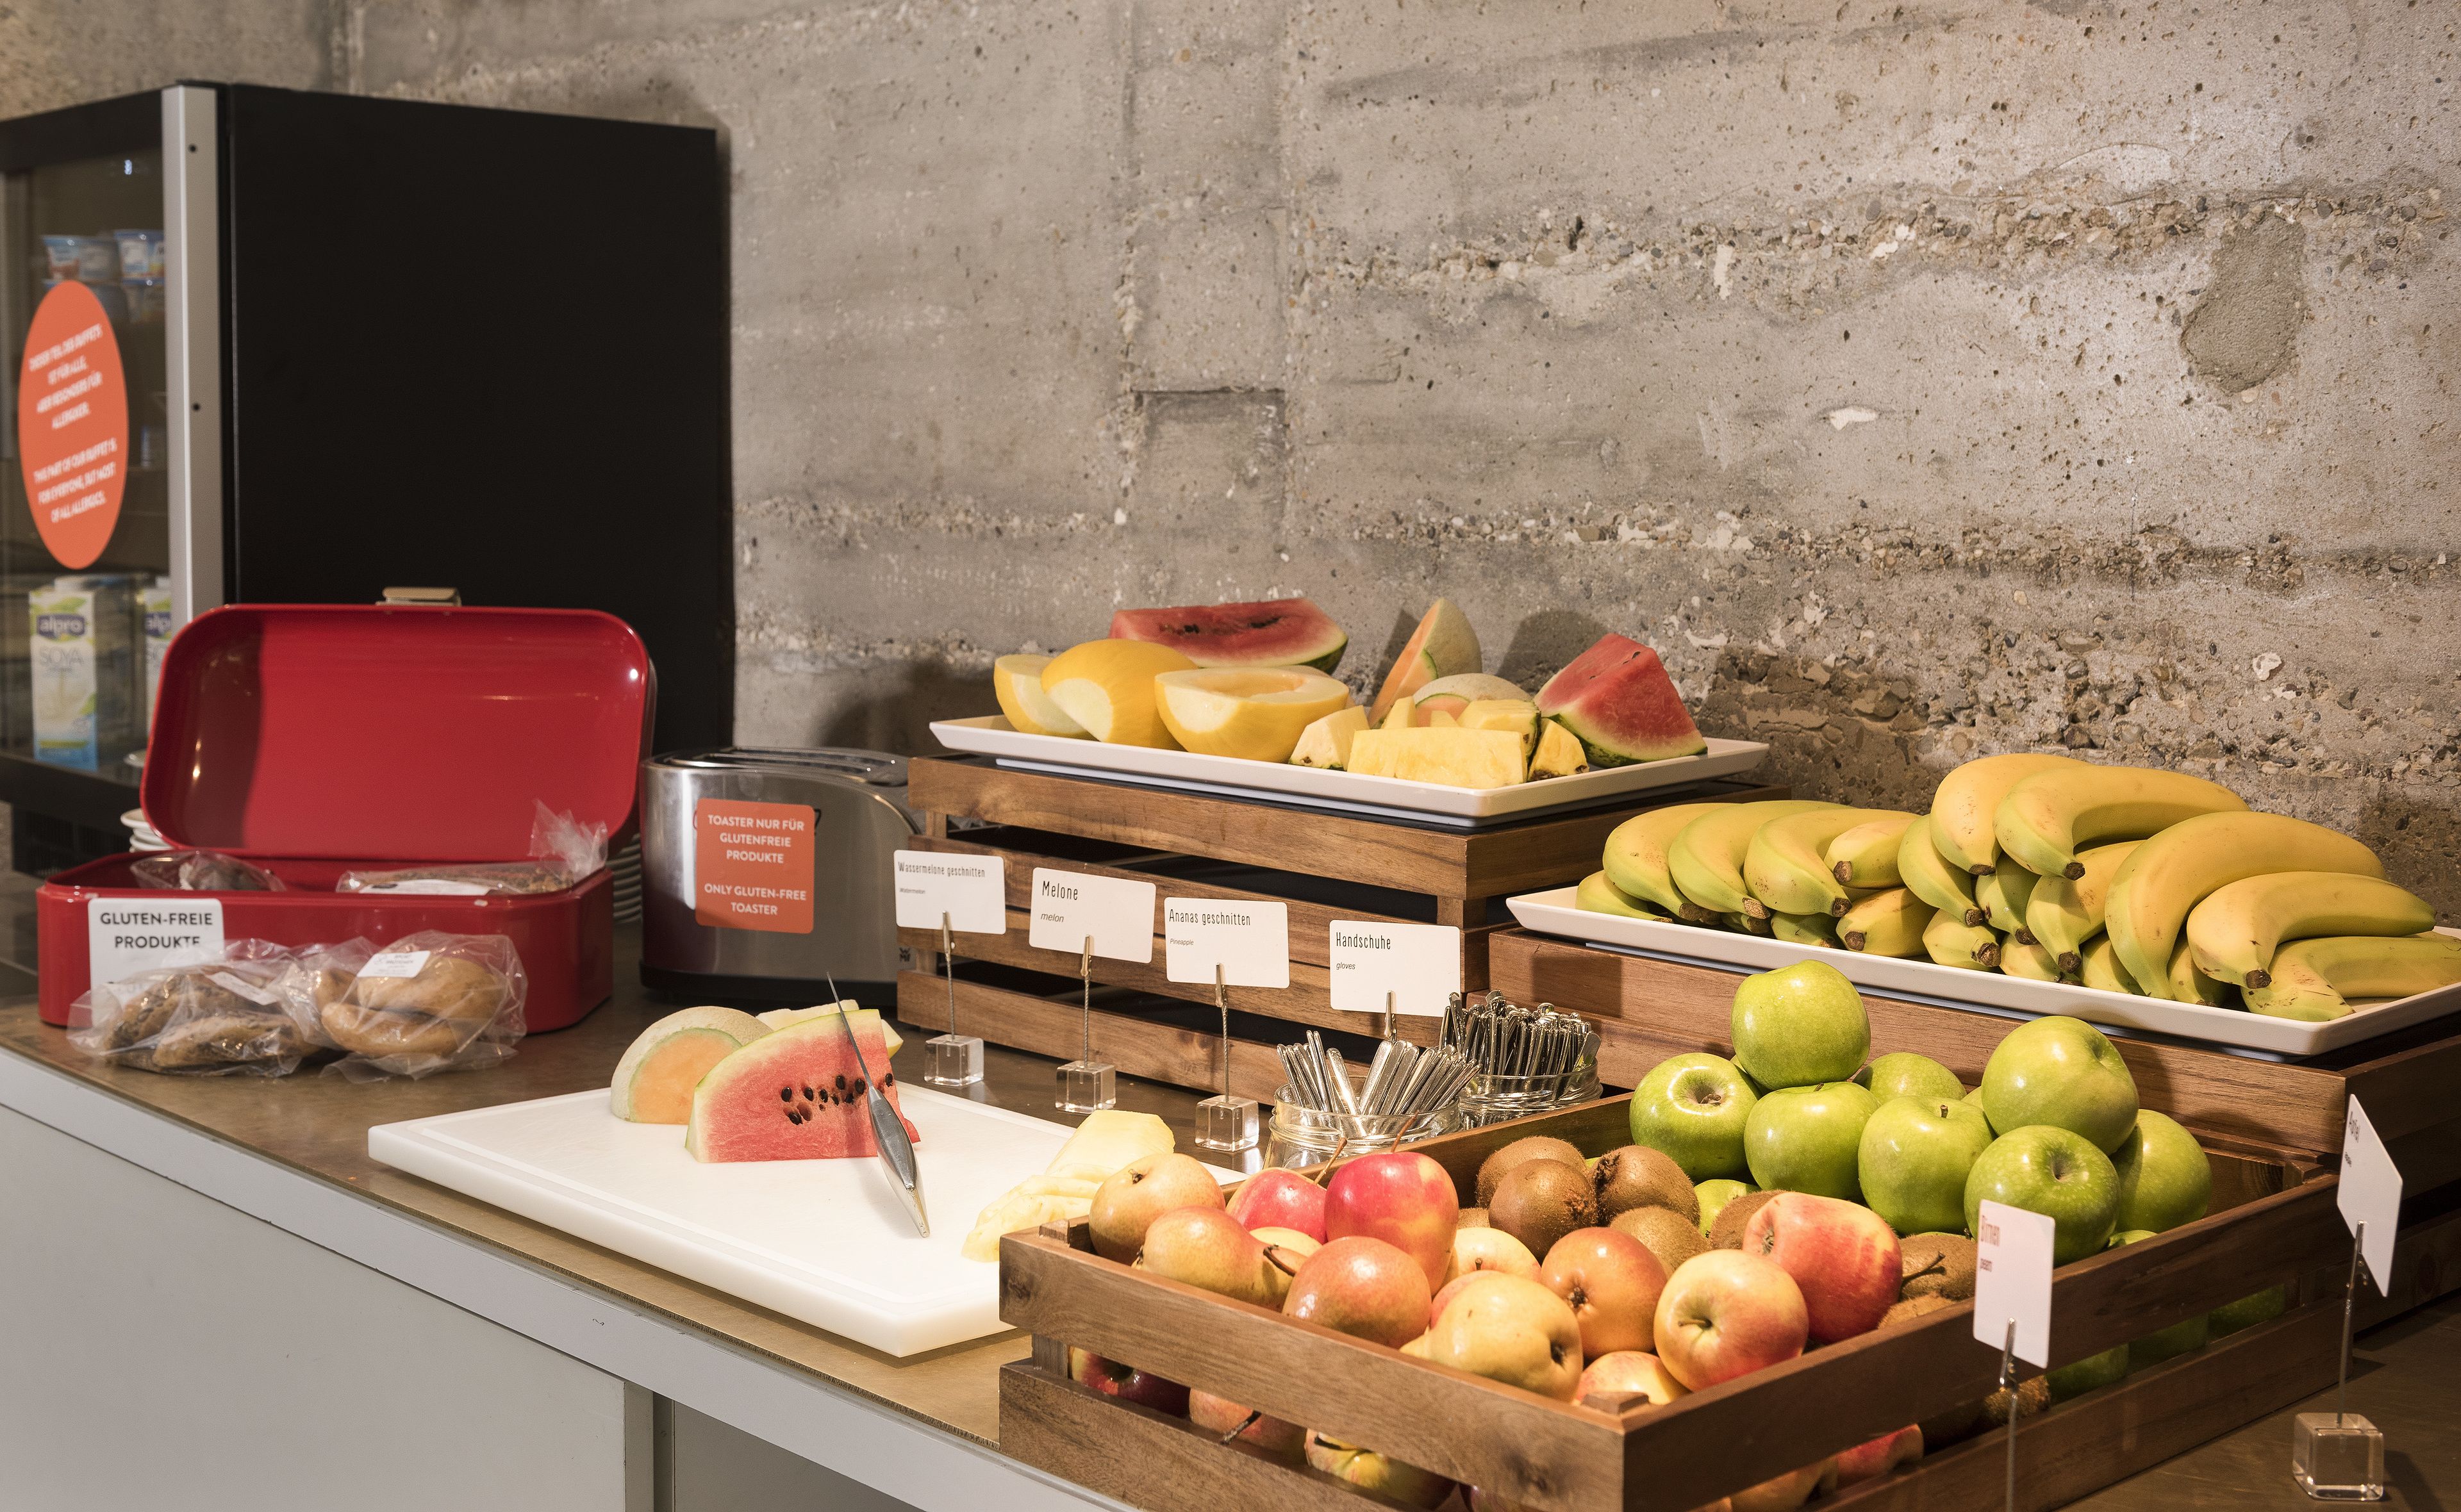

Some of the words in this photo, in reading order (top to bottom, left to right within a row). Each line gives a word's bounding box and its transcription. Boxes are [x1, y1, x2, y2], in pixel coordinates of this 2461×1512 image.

[62, 456, 70, 473] OF
[70, 450, 86, 468] OUR
[85, 440, 108, 463] BUFFET
[38, 489, 51, 505] FOR
[84, 468, 96, 487] BUT
[96, 461, 115, 481] MOST
[40, 614, 83, 636] alpro
[39, 646, 83, 667] SOYA
[708, 814, 754, 828] TOASTER
[756, 819, 779, 830] NUR
[782, 818, 805, 832] FÜR
[720, 832, 791, 848] GLUTENFREIE
[726, 850, 784, 864] PRODUKTE
[898, 861, 945, 875] Wassermelone
[947, 866, 986, 878] geschnitten
[704, 883, 733, 895] ONLY
[733, 885, 807, 901] GLUTEN-FREE
[1042, 880, 1079, 901] Melone
[730, 901, 778, 916] TOASTER
[1169, 908, 1199, 924] Ananas
[1202, 912, 1251, 926] geschnitten
[100, 912, 213, 926] GLUTEN-FREIE
[1041, 912, 1064, 923] melon
[114, 935, 201, 949] PRODUKTE
[1170, 938, 1194, 946] Pineapple
[1336, 932, 1391, 950] Handschuhe
[1336, 962, 1356, 971] gloves
